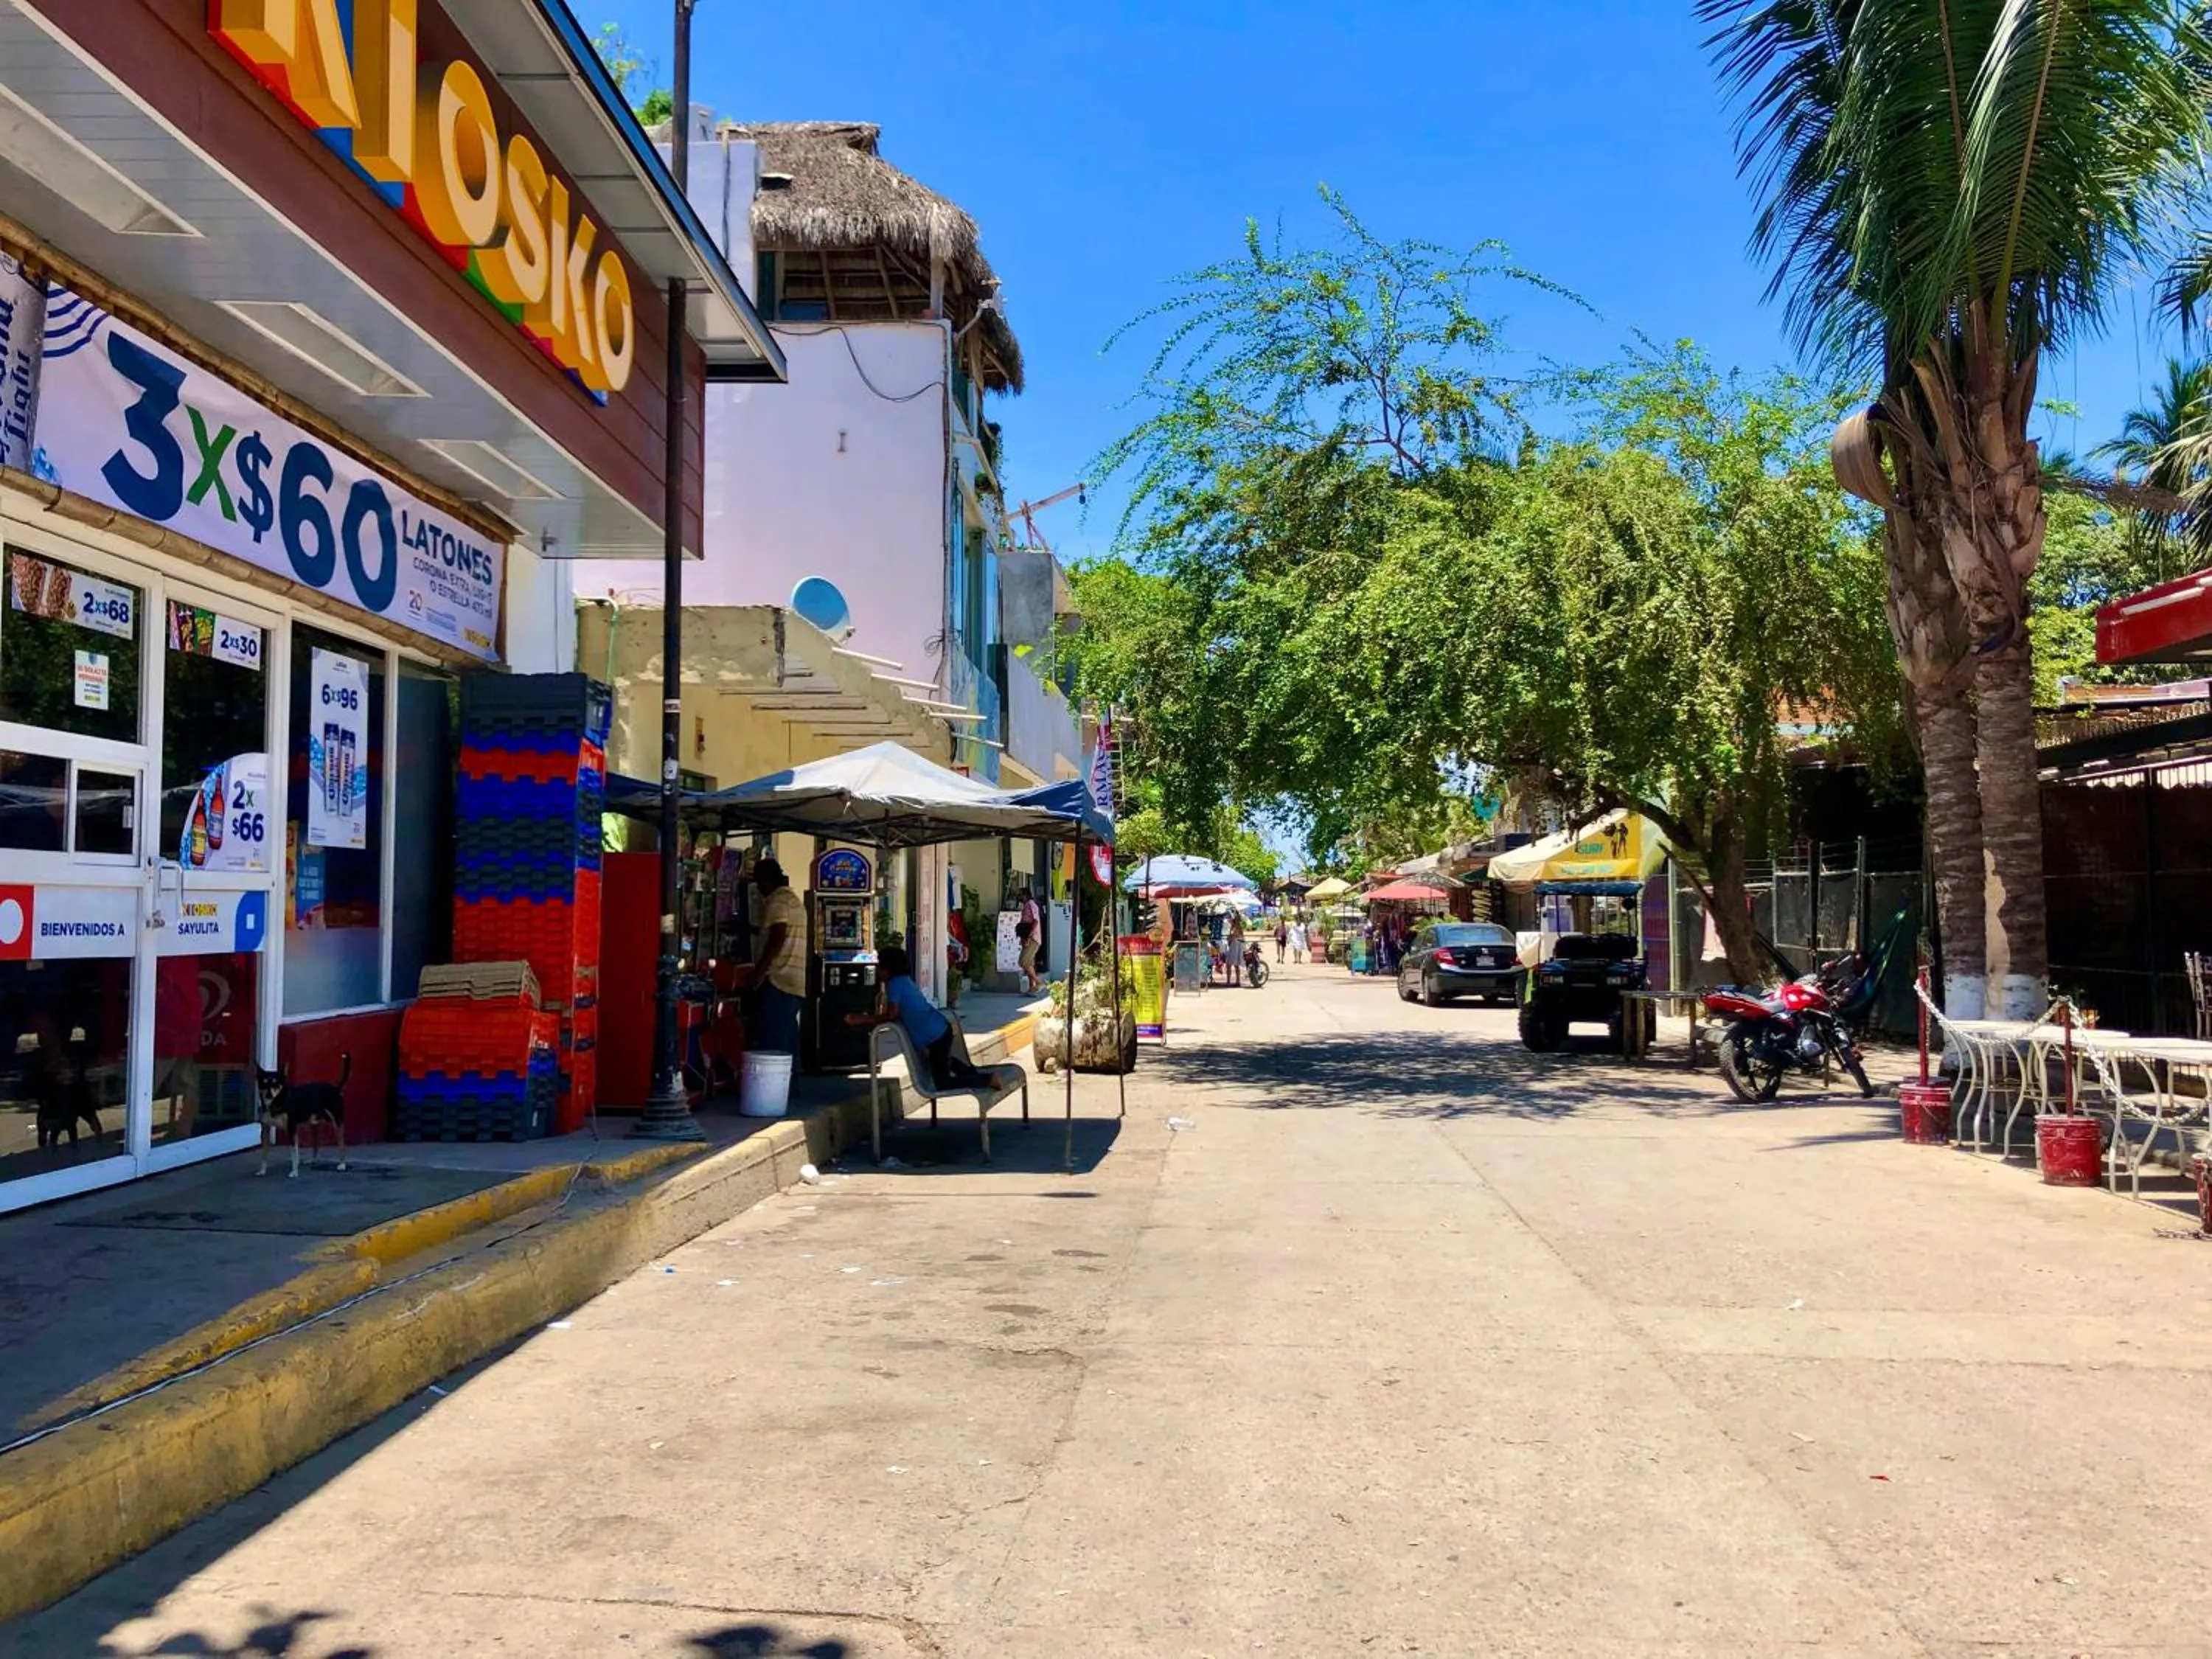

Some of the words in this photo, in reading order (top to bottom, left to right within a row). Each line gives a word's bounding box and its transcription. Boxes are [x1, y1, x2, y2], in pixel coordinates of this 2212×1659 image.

[402, 509, 493, 585] LATONES
[413, 557, 448, 581] CORONA
[83, 591, 129, 624] 2x$68
[232, 780, 254, 810] 2x
[232, 812, 264, 842] $66
[41, 922, 116, 936] BIENVENIDOS
[118, 922, 125, 936] A
[178, 922, 219, 935] SAYULITA
